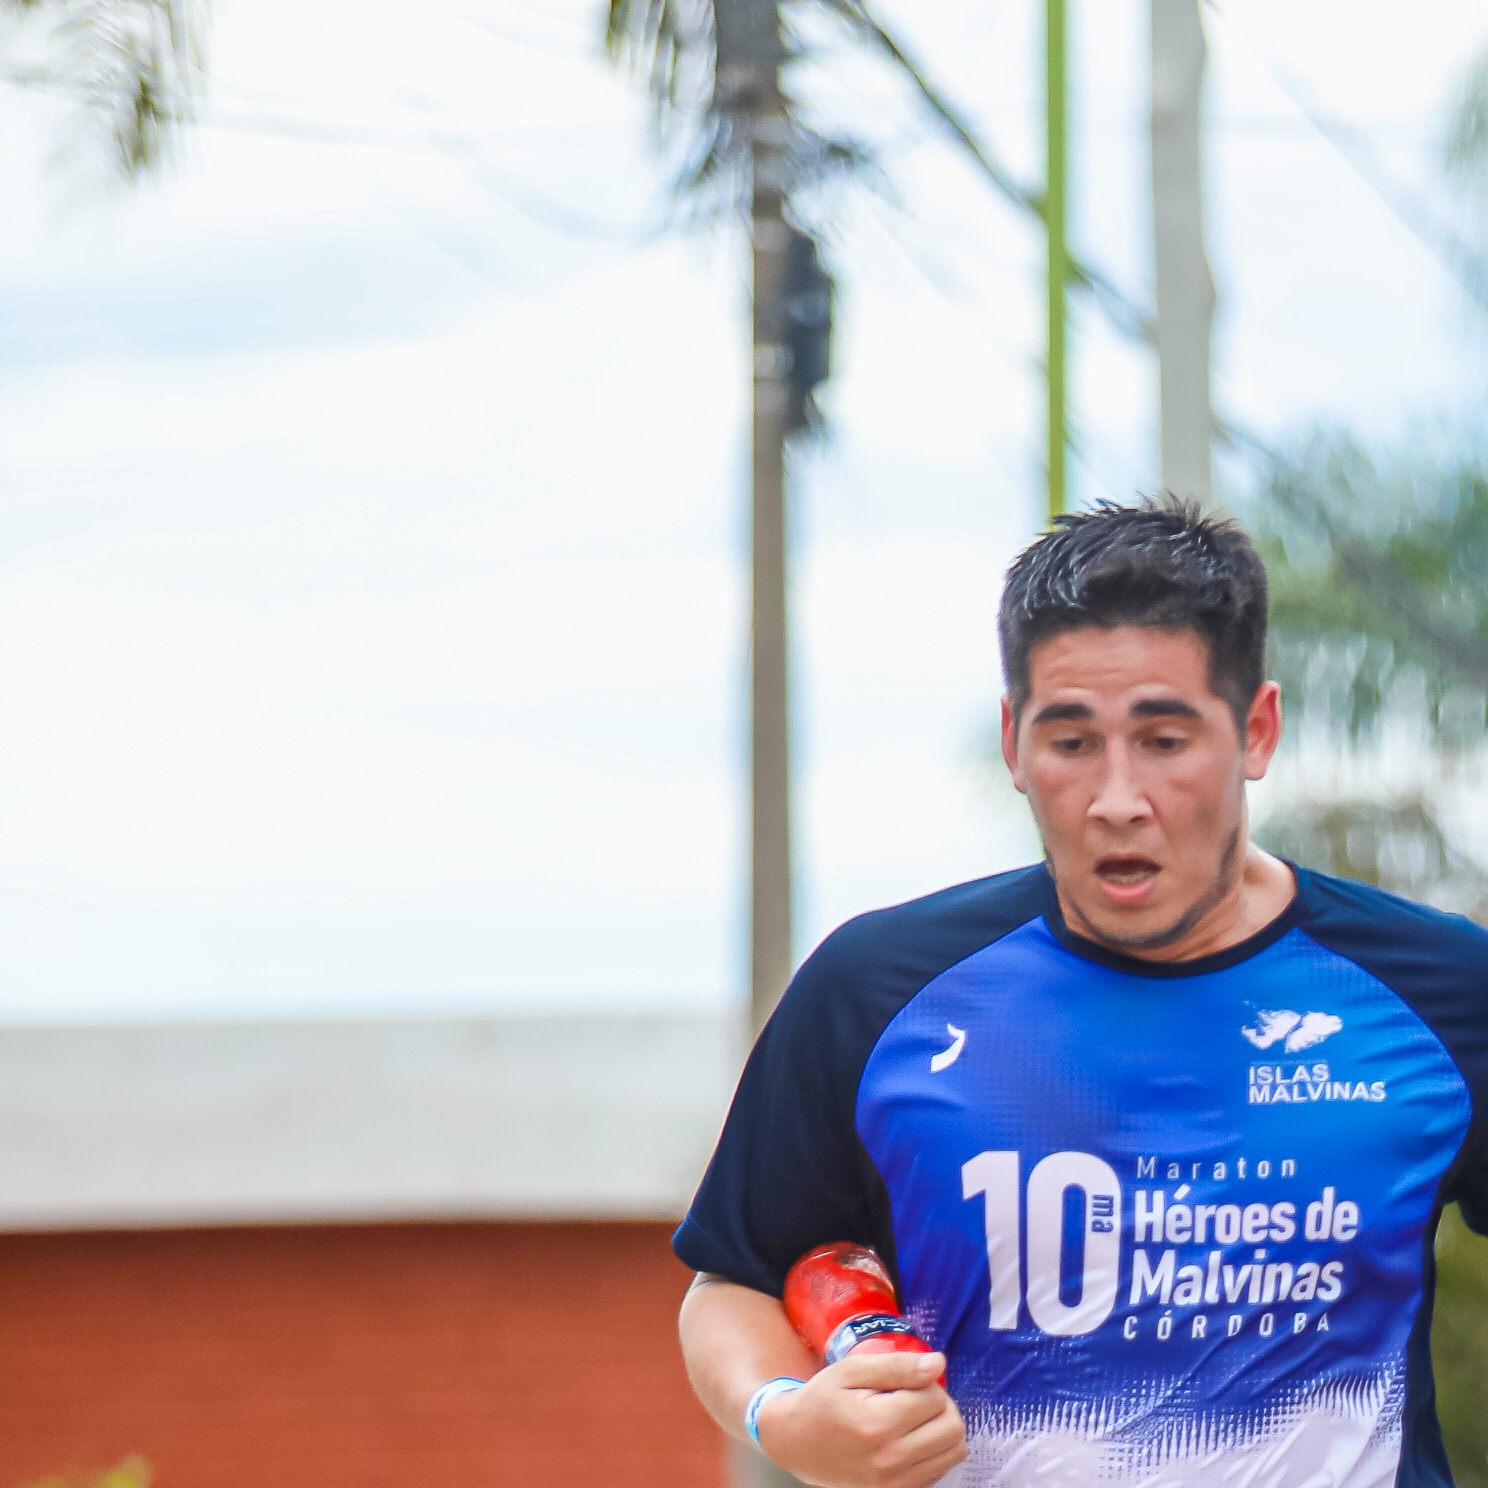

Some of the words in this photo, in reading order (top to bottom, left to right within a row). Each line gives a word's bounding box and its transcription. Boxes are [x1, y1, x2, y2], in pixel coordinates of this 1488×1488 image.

[1249, 1063, 1330, 1085] ISLAS
[1249, 1081, 1386, 1104] MALVINAS
[1137, 1155, 1297, 1180] Maraton
[1134, 1183, 1296, 1244] Héroes
[1304, 1186, 1360, 1242] de
[961, 1150, 1122, 1337] 10
[1129, 1248, 1343, 1307] Malvinas
[1123, 1309, 1331, 1341] CÓRDOBA
